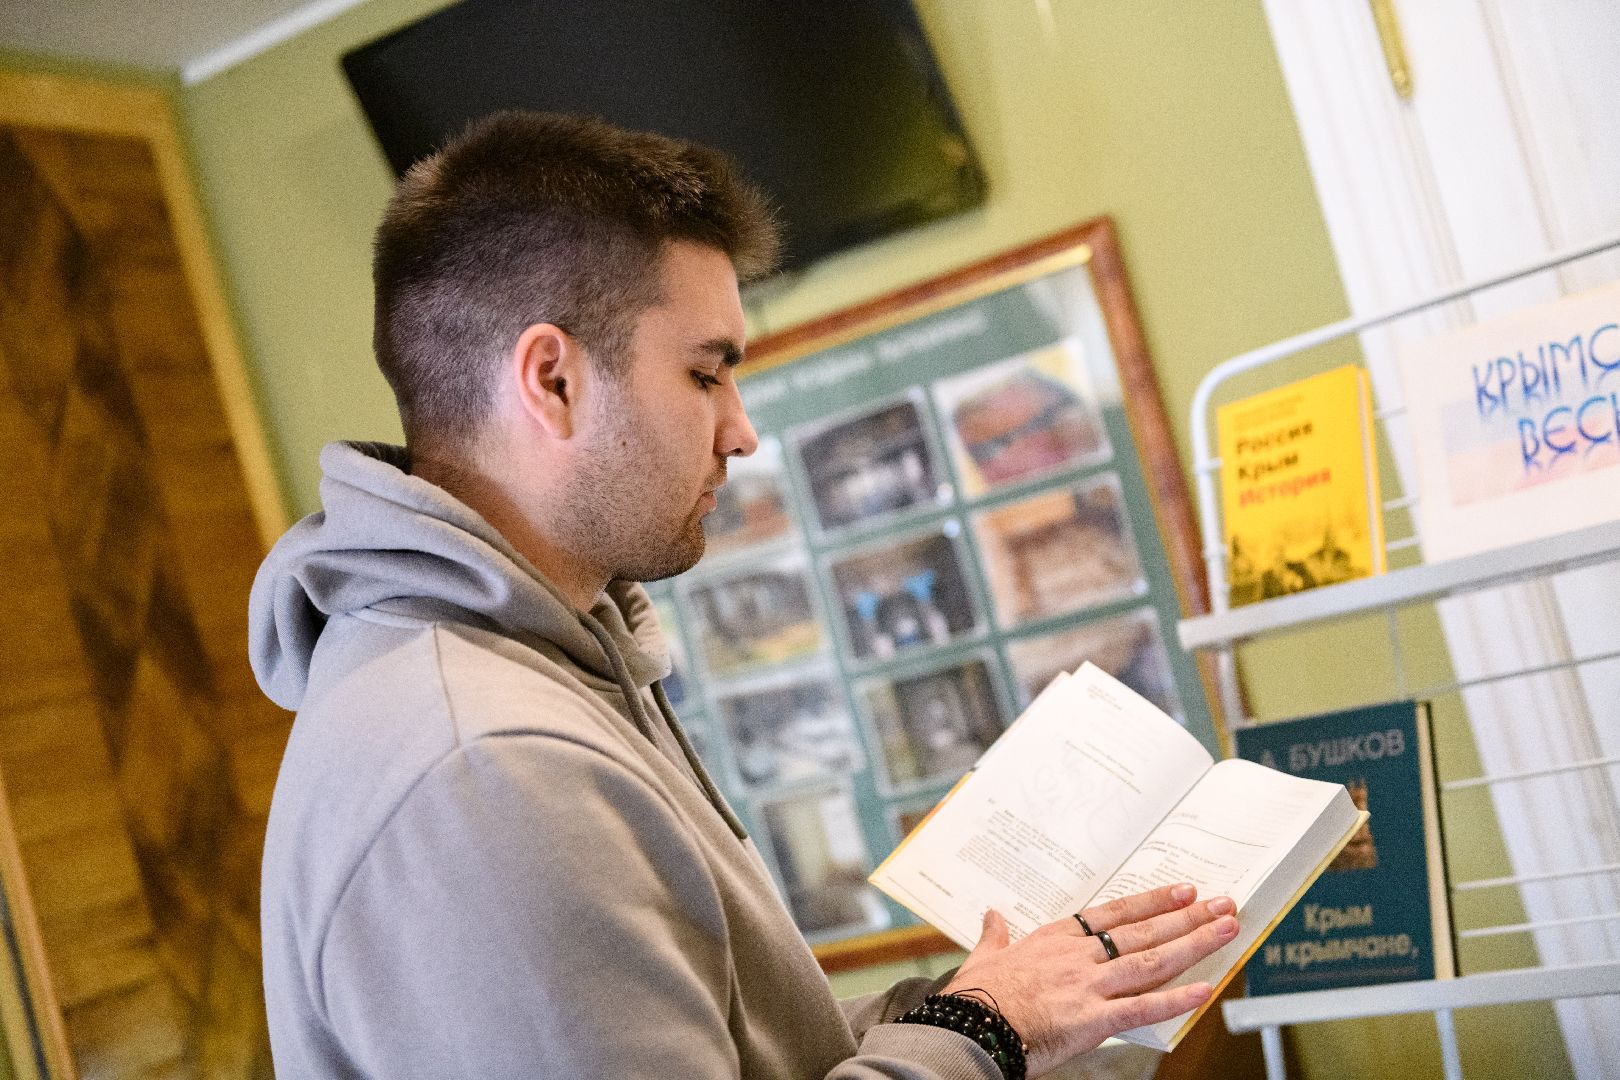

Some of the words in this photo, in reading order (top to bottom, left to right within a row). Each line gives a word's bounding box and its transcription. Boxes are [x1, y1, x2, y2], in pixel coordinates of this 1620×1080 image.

[1236, 419, 1313, 456] Россия
[1238, 452, 1299, 481] Крым
[1239, 468, 1332, 507] История
[1289, 729, 1405, 771] БУШКОВ
[1304, 904, 1373, 934] Крым
[1265, 943, 1282, 966] и
